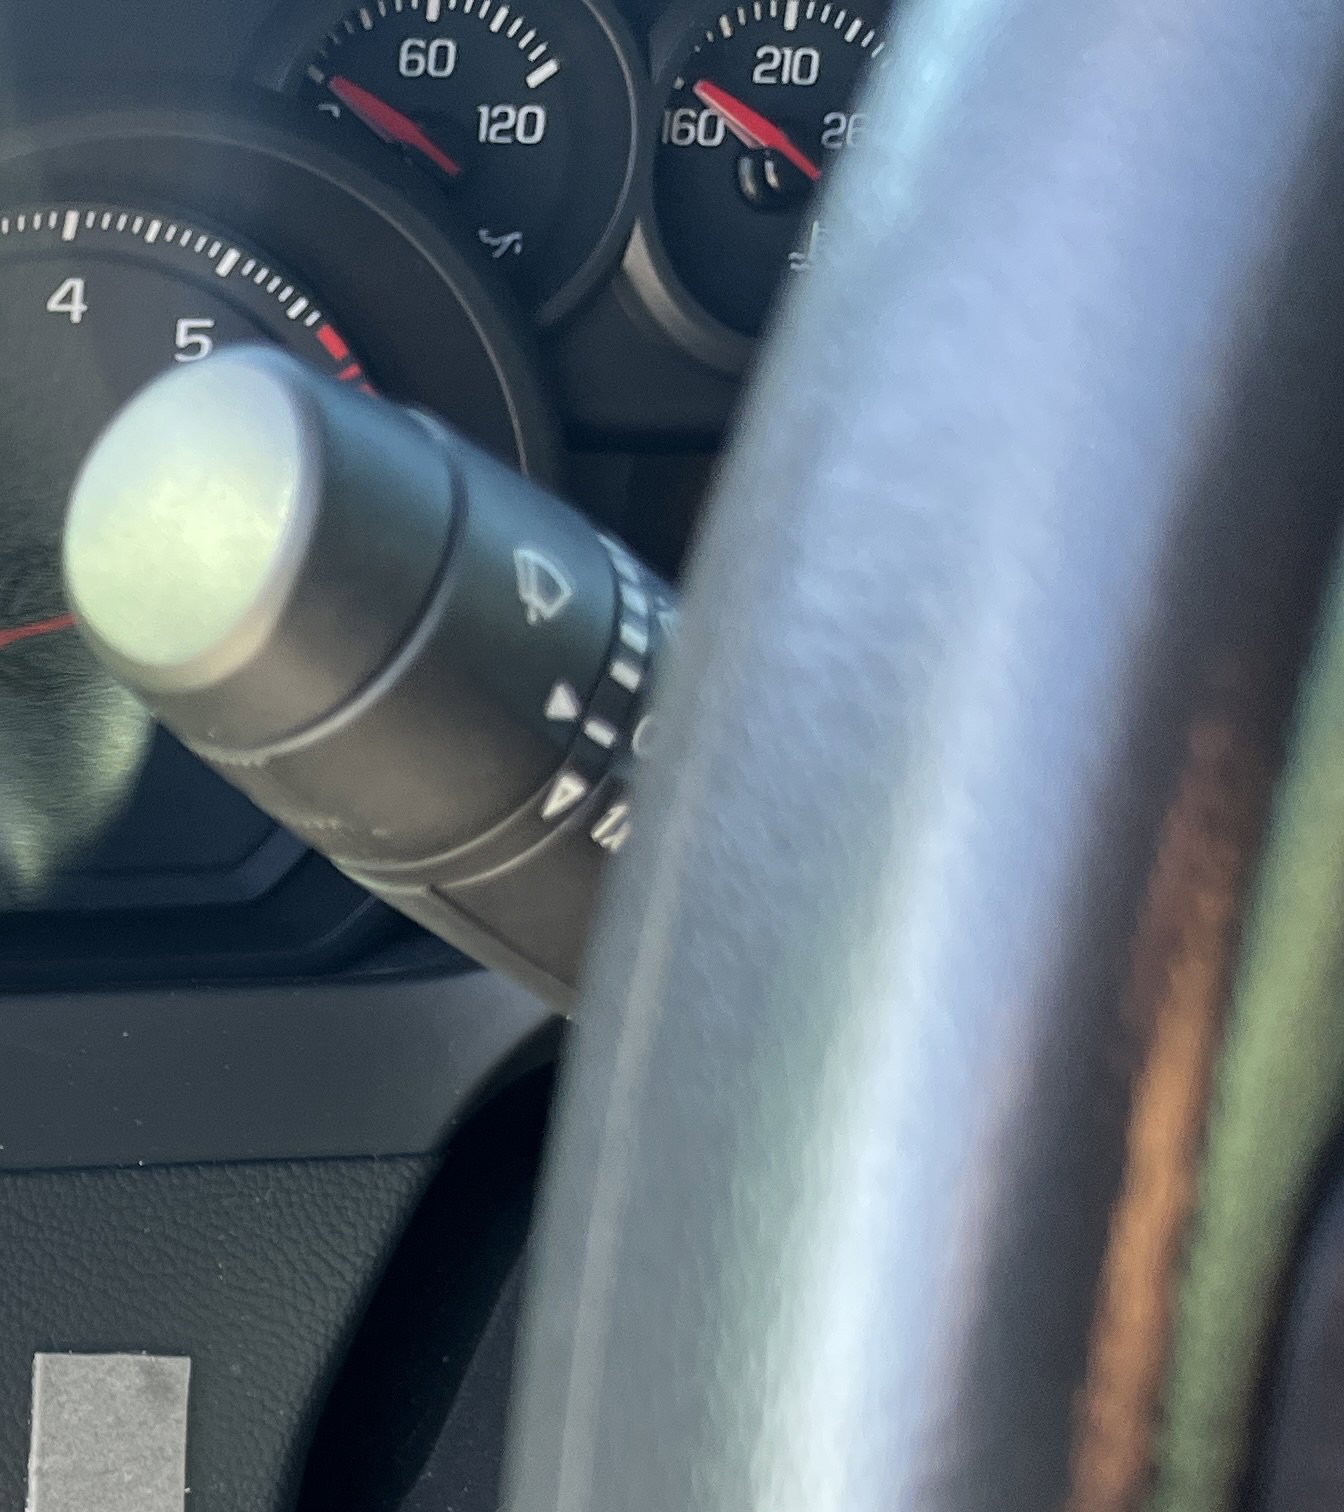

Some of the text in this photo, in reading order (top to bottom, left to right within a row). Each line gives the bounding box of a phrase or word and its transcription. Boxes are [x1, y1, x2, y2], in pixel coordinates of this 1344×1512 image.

[398, 38, 457, 78] 60
[752, 46, 820, 86] 210
[478, 104, 547, 144] 120
[661, 107, 725, 147] 160
[46, 278, 88, 323] 4
[174, 318, 214, 361] 5
